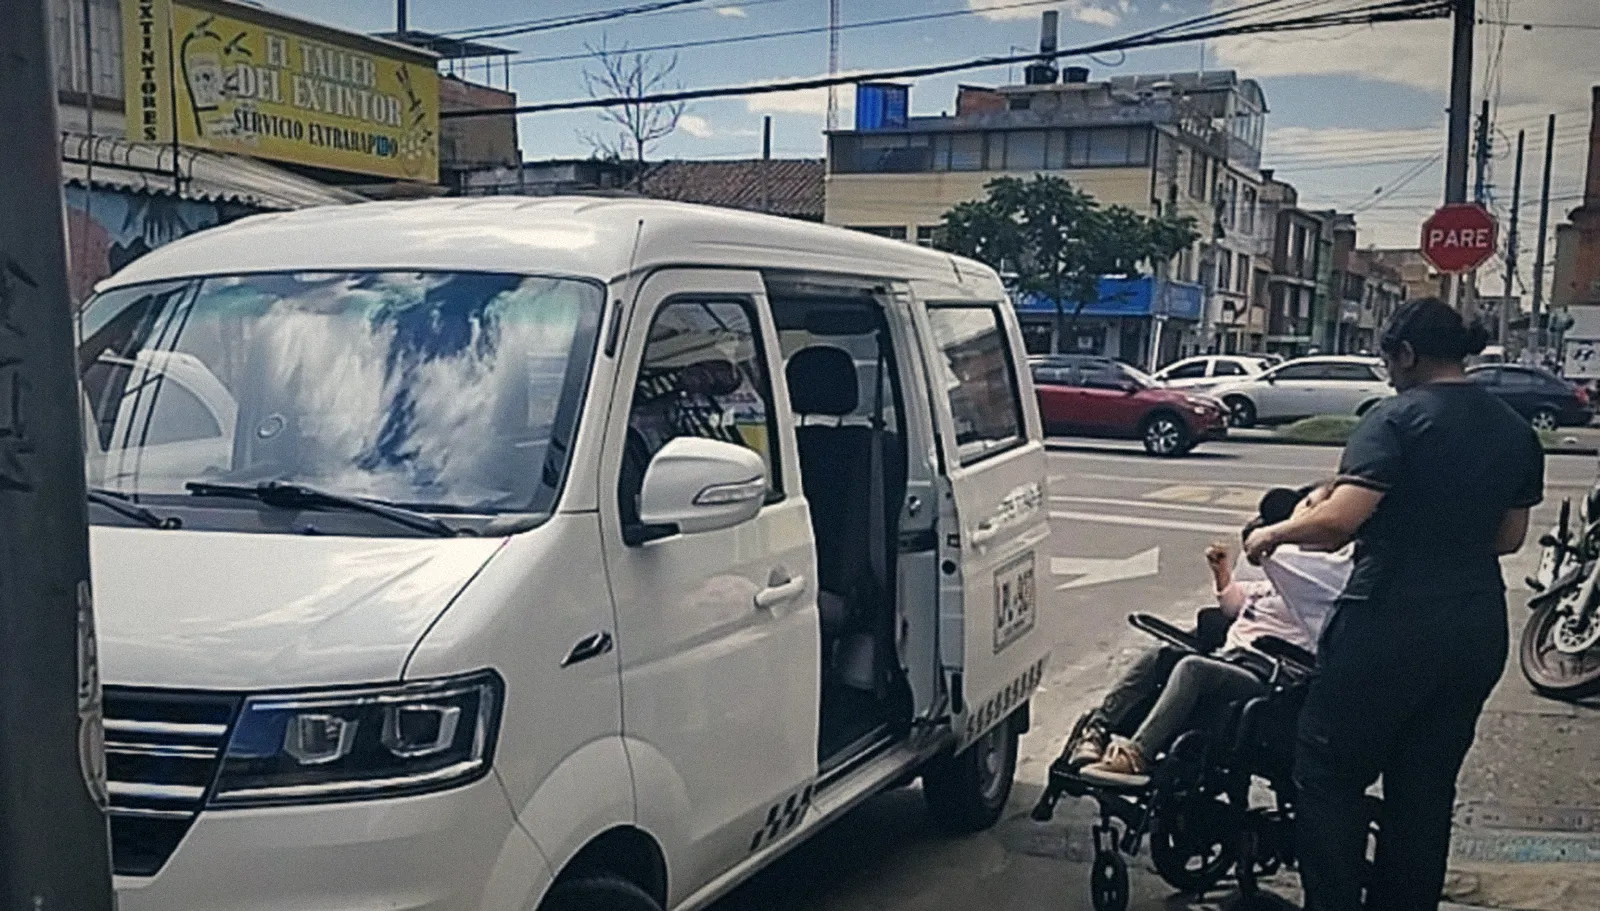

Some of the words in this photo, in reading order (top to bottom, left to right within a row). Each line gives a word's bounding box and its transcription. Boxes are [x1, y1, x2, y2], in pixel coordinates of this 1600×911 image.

[139, 0, 157, 141] XTINTORES
[265, 33, 290, 69] EL
[300, 44, 377, 88] TALLER
[235, 63, 286, 104] DEL
[292, 74, 402, 127] EXTINTOR
[232, 107, 304, 141] SERVICIO
[308, 120, 399, 159] EXTRARAPIDO
[1429, 228, 1489, 248] PARE
